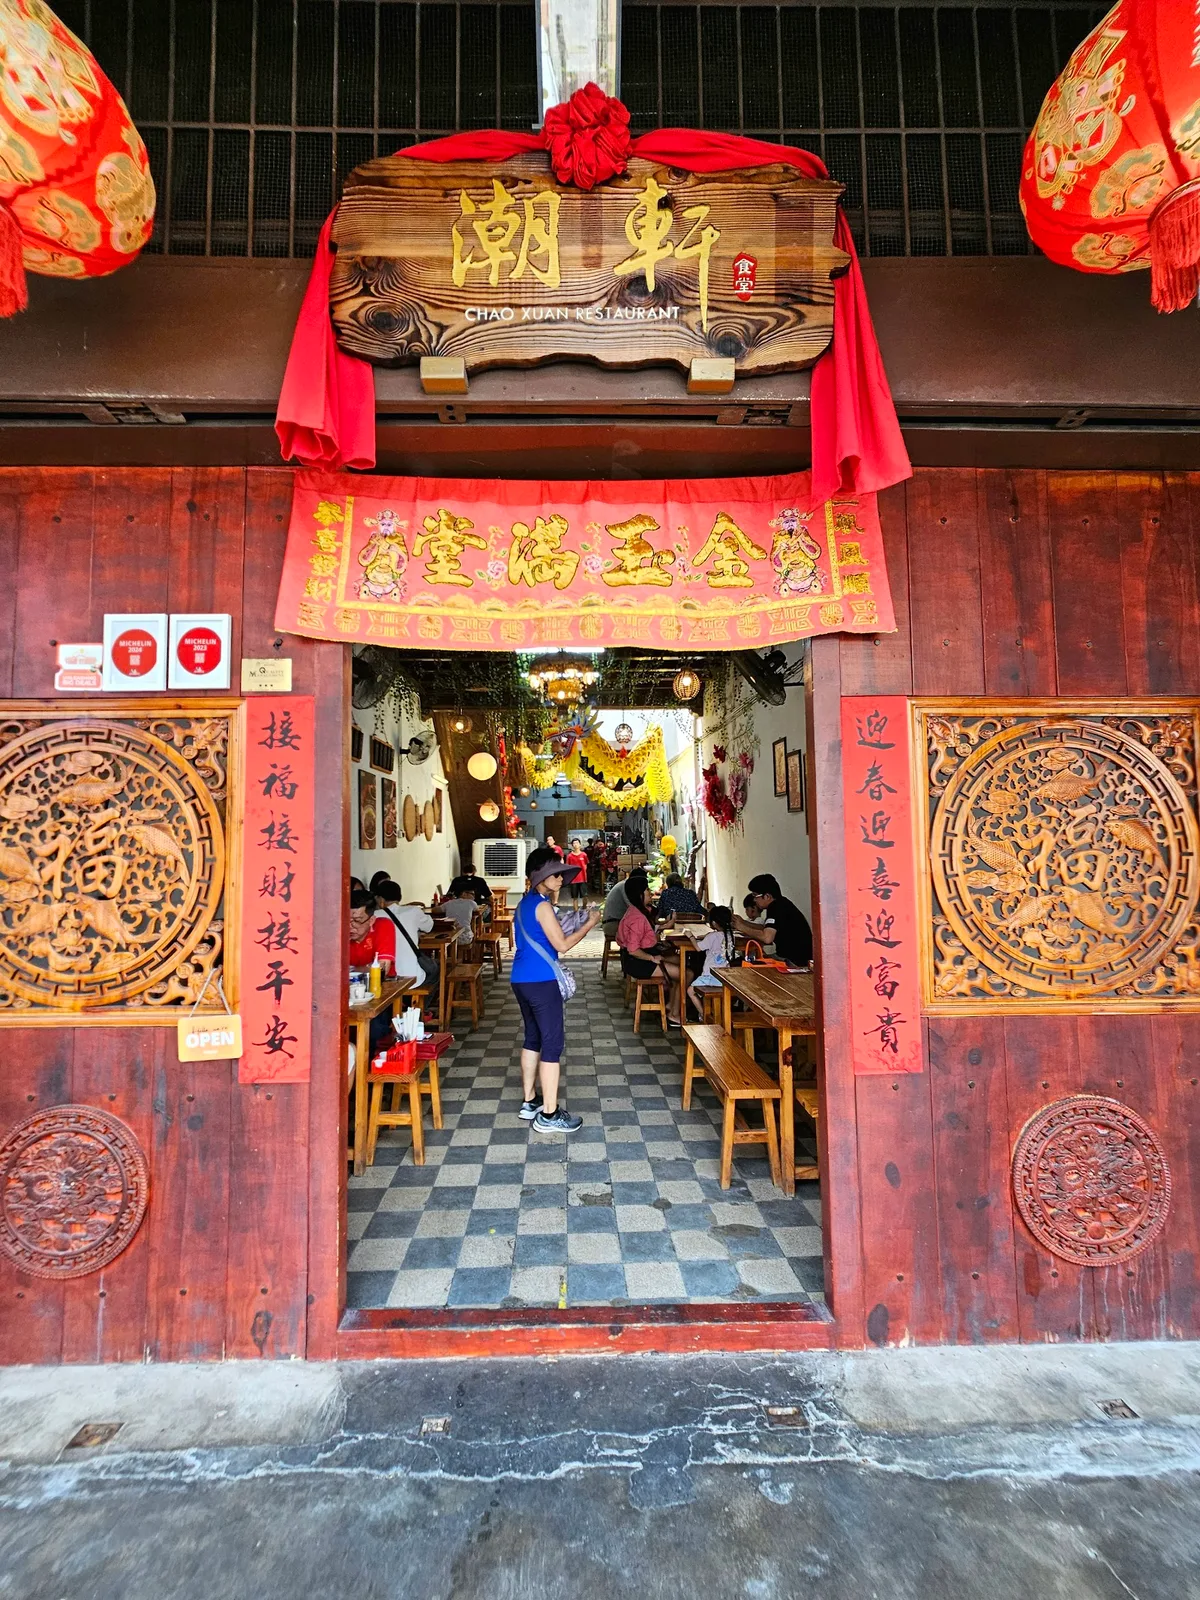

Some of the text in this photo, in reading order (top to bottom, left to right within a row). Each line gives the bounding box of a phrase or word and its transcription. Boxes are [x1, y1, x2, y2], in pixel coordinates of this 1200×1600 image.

[734, 258, 755, 294] 食堂
[465, 305, 681, 322] CHAO XUAN RESTAURANT
[252, 711, 302, 1059] 接福接財接平安
[856, 710, 907, 1054] 迎春迎喜迎富貴
[186, 1031, 235, 1048] OPEN
